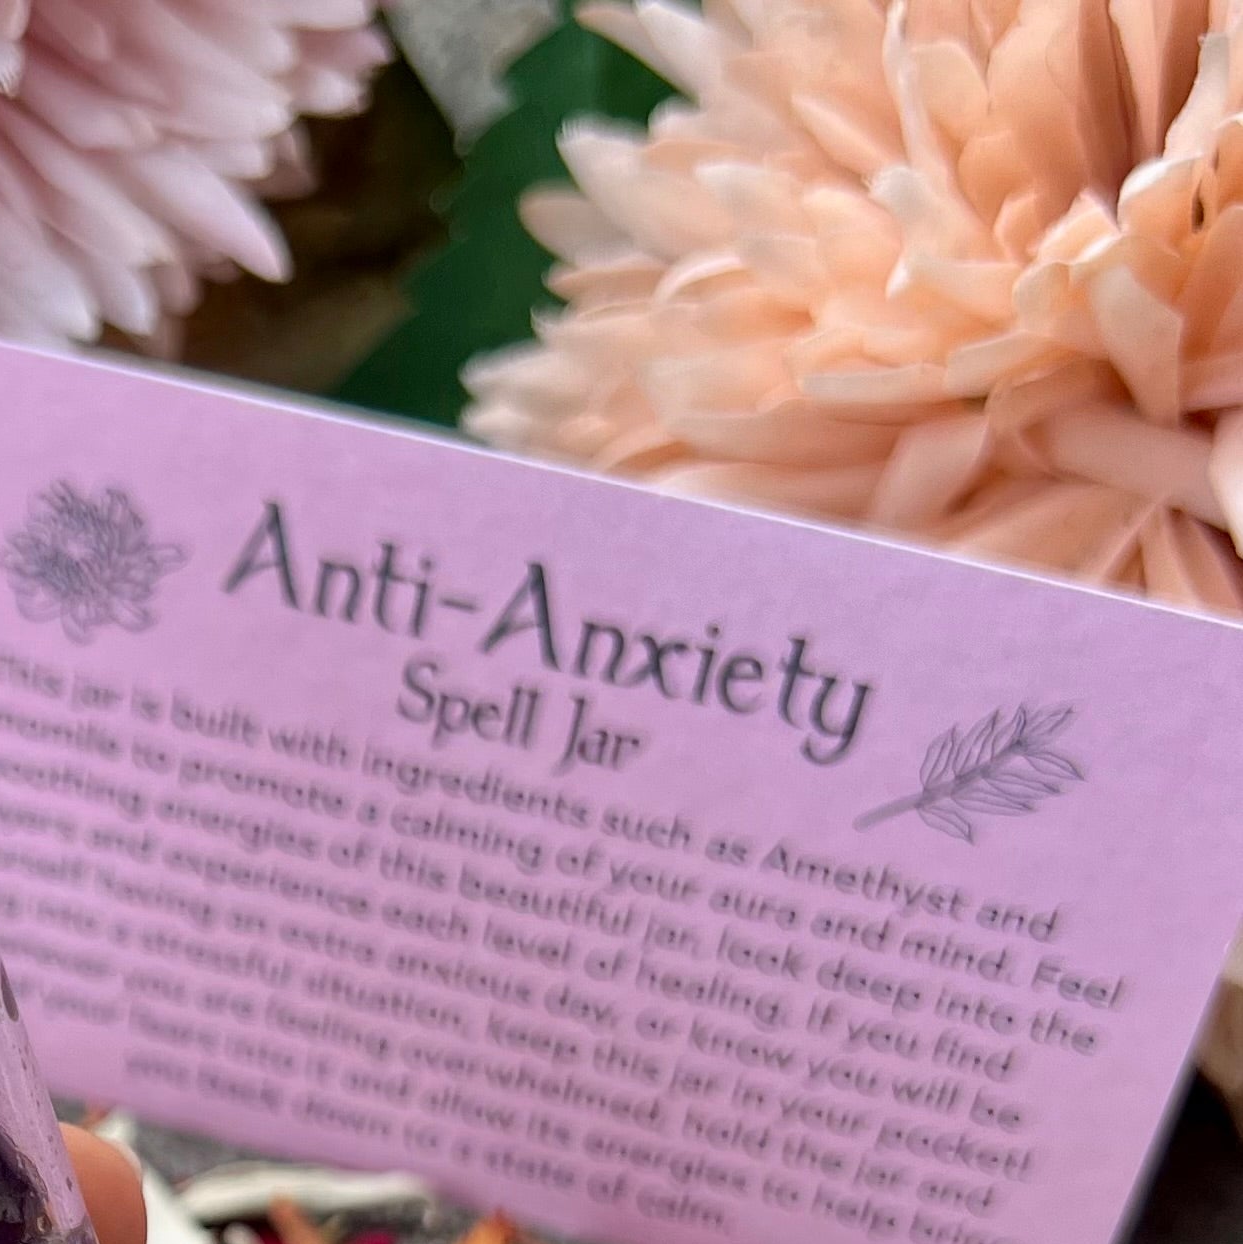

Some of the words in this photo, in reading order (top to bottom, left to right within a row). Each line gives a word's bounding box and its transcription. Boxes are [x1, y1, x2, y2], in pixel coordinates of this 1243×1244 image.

[222, 498, 874, 767] Anti-Anxiety
[397, 657, 543, 752] Spell
[554, 695, 641, 775] Jar
[169, 693, 263, 746] built
[266, 726, 353, 768] with
[361, 741, 593, 827] ingredients
[602, 810, 695, 851] such
[704, 835, 751, 865] as
[760, 838, 970, 920] Amethyst
[975, 902, 1066, 943] and
[326, 836, 371, 870] of
[376, 846, 449, 891] this
[456, 863, 640, 939] beautiful
[715, 929, 811, 982] look
[815, 954, 928, 1020] deep
[934, 984, 1024, 1036] into
[1030, 1012, 1103, 1056] the
[388, 808, 547, 876] calming
[554, 845, 602, 880] of
[606, 863, 701, 905] your
[708, 888, 804, 931] aura
[809, 913, 894, 953] and
[1032, 958, 1127, 1011] Feel
[379, 903, 472, 945] each
[481, 918, 575, 971] level
[581, 950, 629, 985] of
[806, 1001, 842, 1039] If
[844, 1021, 921, 1059] you
[932, 1032, 1021, 1084] find
[590, 1042, 668, 1088] this
[667, 1058, 722, 1102] jar
[728, 1074, 770, 1114] in
[774, 1097, 869, 1140] your
[631, 1014, 679, 1045] or
[685, 1017, 794, 1074] know
[802, 1058, 884, 1097] you
[889, 1078, 962, 1117] will
[968, 1090, 1028, 1134] be
[681, 1106, 775, 1159] hold
[779, 1136, 848, 1179] the
[850, 1150, 906, 1194] jar
[913, 1177, 1002, 1218] and
[811, 1182, 900, 1244] help
